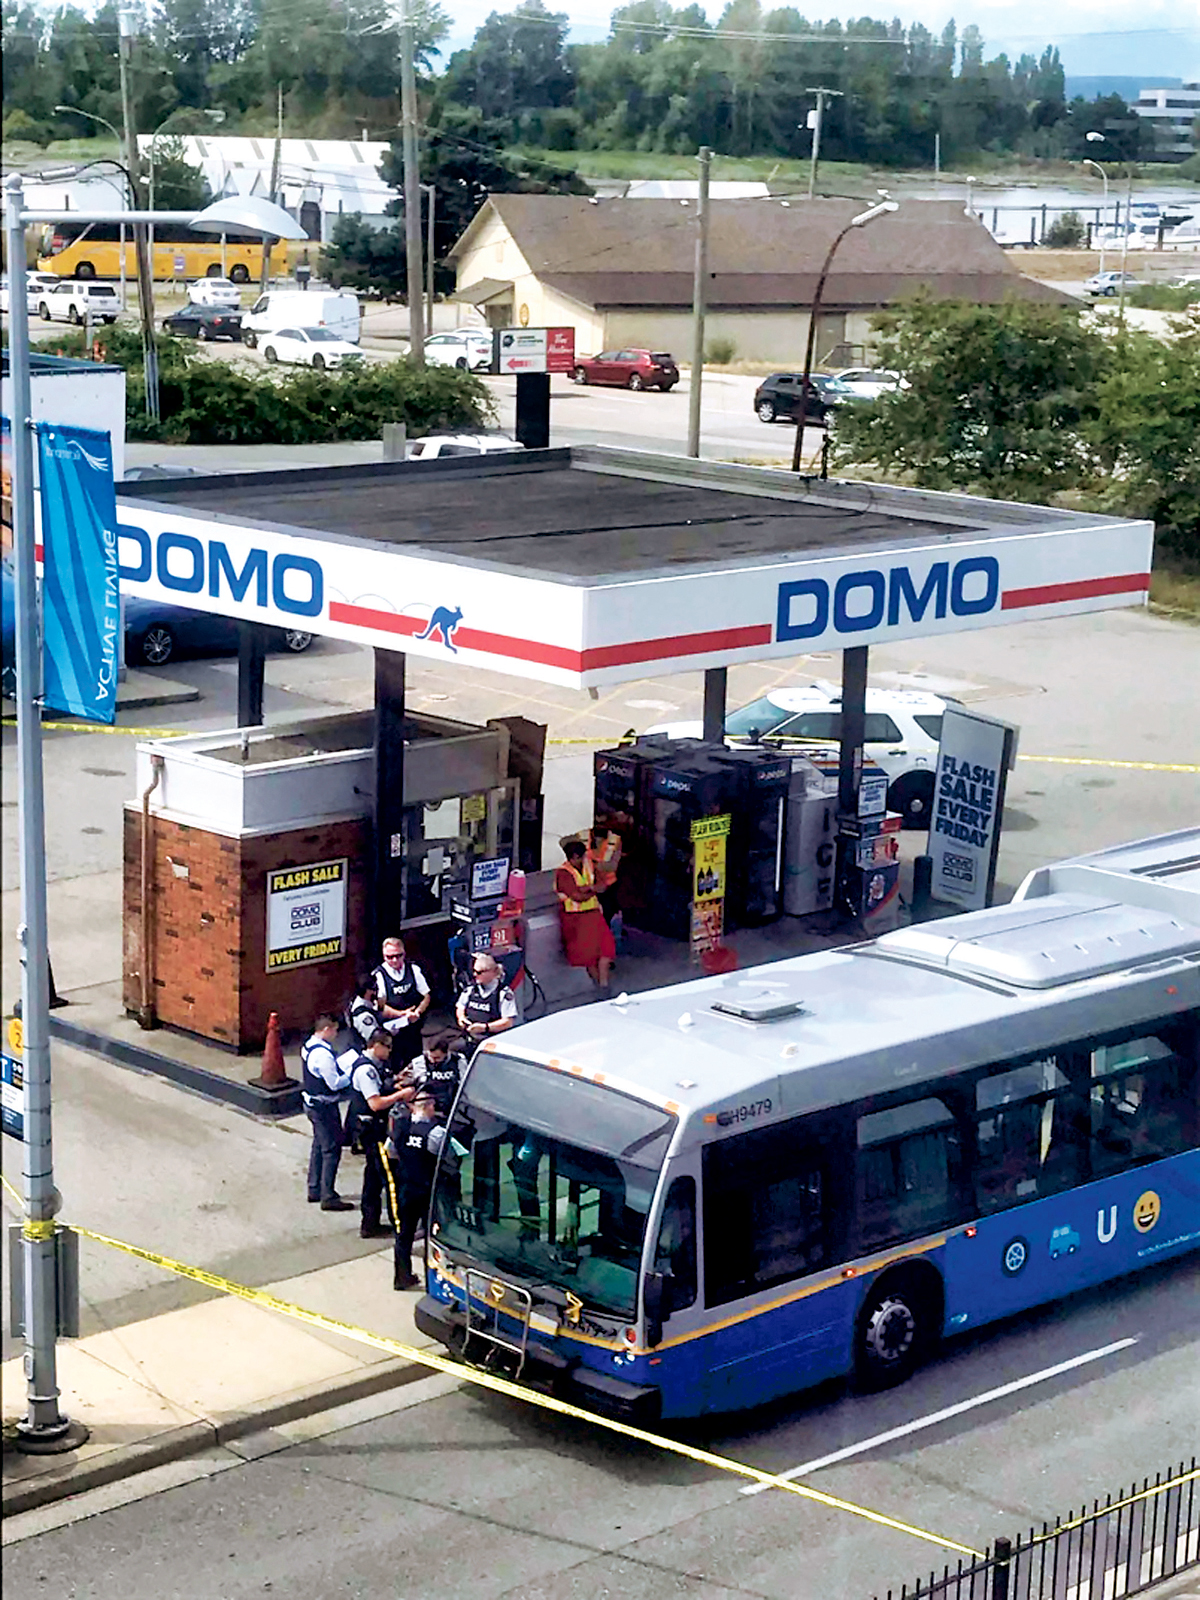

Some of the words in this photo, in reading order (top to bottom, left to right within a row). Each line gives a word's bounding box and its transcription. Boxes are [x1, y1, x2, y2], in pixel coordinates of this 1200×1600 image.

[116, 523, 324, 618] DOMO
[775, 556, 999, 642] DOMO
[942, 755, 995, 788] FLASH
[940, 773, 994, 812] SALE
[938, 798, 991, 830] EVERY
[935, 816, 989, 848] FRIDAY
[273, 871, 310, 890] FLASH
[312, 865, 340, 883] SALE
[290, 917, 321, 930] CLUB
[291, 904, 320, 919] DOMO
[475, 933, 490, 947] 87
[494, 929, 506, 943] 91
[269, 948, 303, 967] EVERY
[303, 940, 340, 959] FRIDAY
[468, 1001, 491, 1012] POLICE
[1097, 1205, 1117, 1244] U
